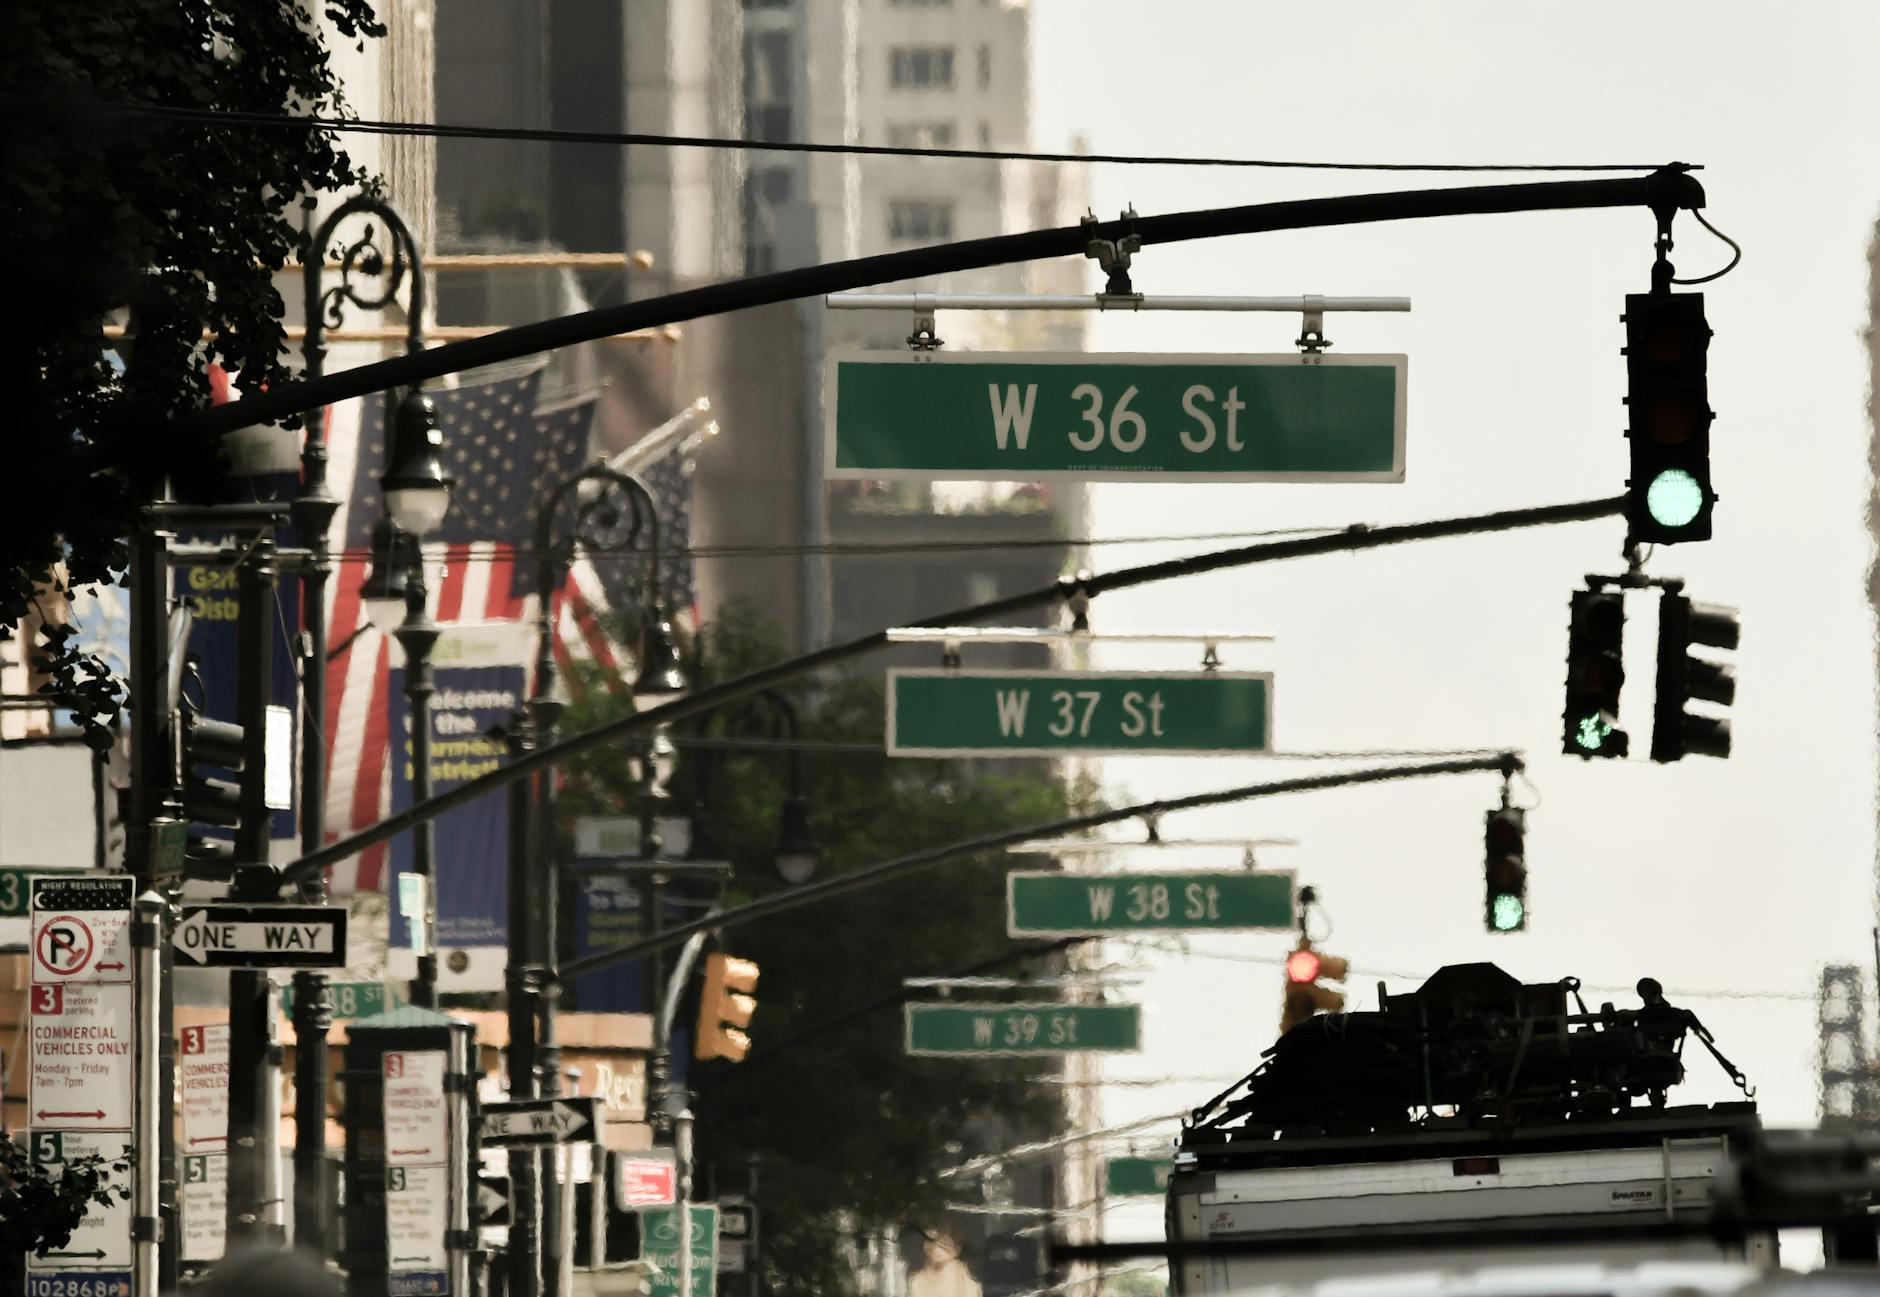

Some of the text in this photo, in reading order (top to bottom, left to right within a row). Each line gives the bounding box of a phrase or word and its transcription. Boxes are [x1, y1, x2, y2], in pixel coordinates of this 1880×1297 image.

[988, 383, 1247, 453] W 36 St
[404, 689, 516, 710] elcome
[996, 690, 1166, 737] W 37 St
[434, 712, 477, 735] the
[41, 882, 123, 891] NIGHT REGULATION
[1088, 883, 1221, 921] W 38 St
[184, 925, 322, 949] ONE WAY
[38, 985, 57, 1013] 3
[64, 997, 99, 1006] metered
[364, 986, 385, 1002] ST
[64, 1007, 95, 1016] parking
[34, 1026, 117, 1039] COMMERCIAL
[972, 1014, 1079, 1046] W 39 St
[34, 1042, 129, 1055] VEHICLES ONLY
[187, 1028, 199, 1054] 3
[34, 1063, 72, 1074] Monday
[80, 1063, 110, 1074] Friday
[185, 1063, 229, 1076] COMMERC
[35, 1077, 55, 1087] 7am
[63, 1077, 84, 1088] 7pm
[528, 1112, 573, 1130] WAY
[38, 1134, 56, 1162] 5
[64, 1146, 99, 1154] metered
[190, 1158, 202, 1182] 5
[1612, 1190, 1653, 1200] SPARTAN
[80, 1217, 105, 1228] night
[648, 1252, 712, 1270] udon
